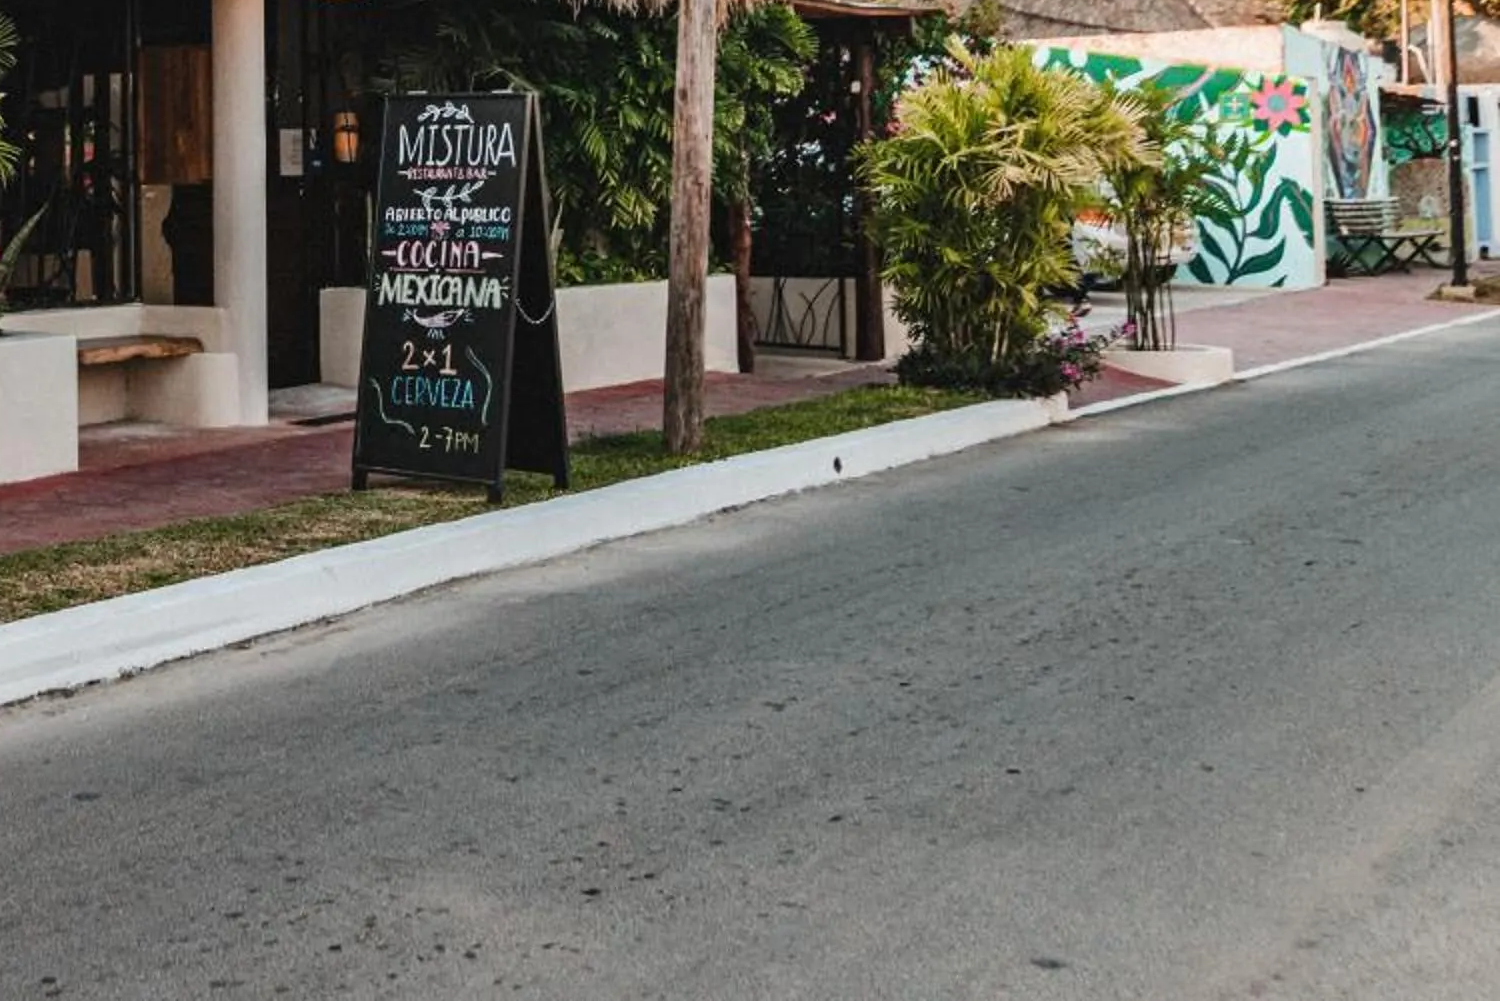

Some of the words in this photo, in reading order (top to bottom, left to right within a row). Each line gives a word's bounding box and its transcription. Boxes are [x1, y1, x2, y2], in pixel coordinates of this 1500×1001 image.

[398, 122, 517, 168] MISTURA
[384, 206, 443, 222] ABIERTO
[443, 207, 461, 222] AL
[396, 240, 480, 268] COCINA
[377, 273, 503, 310] MEXICANA
[390, 375, 475, 409] CERVEZA
